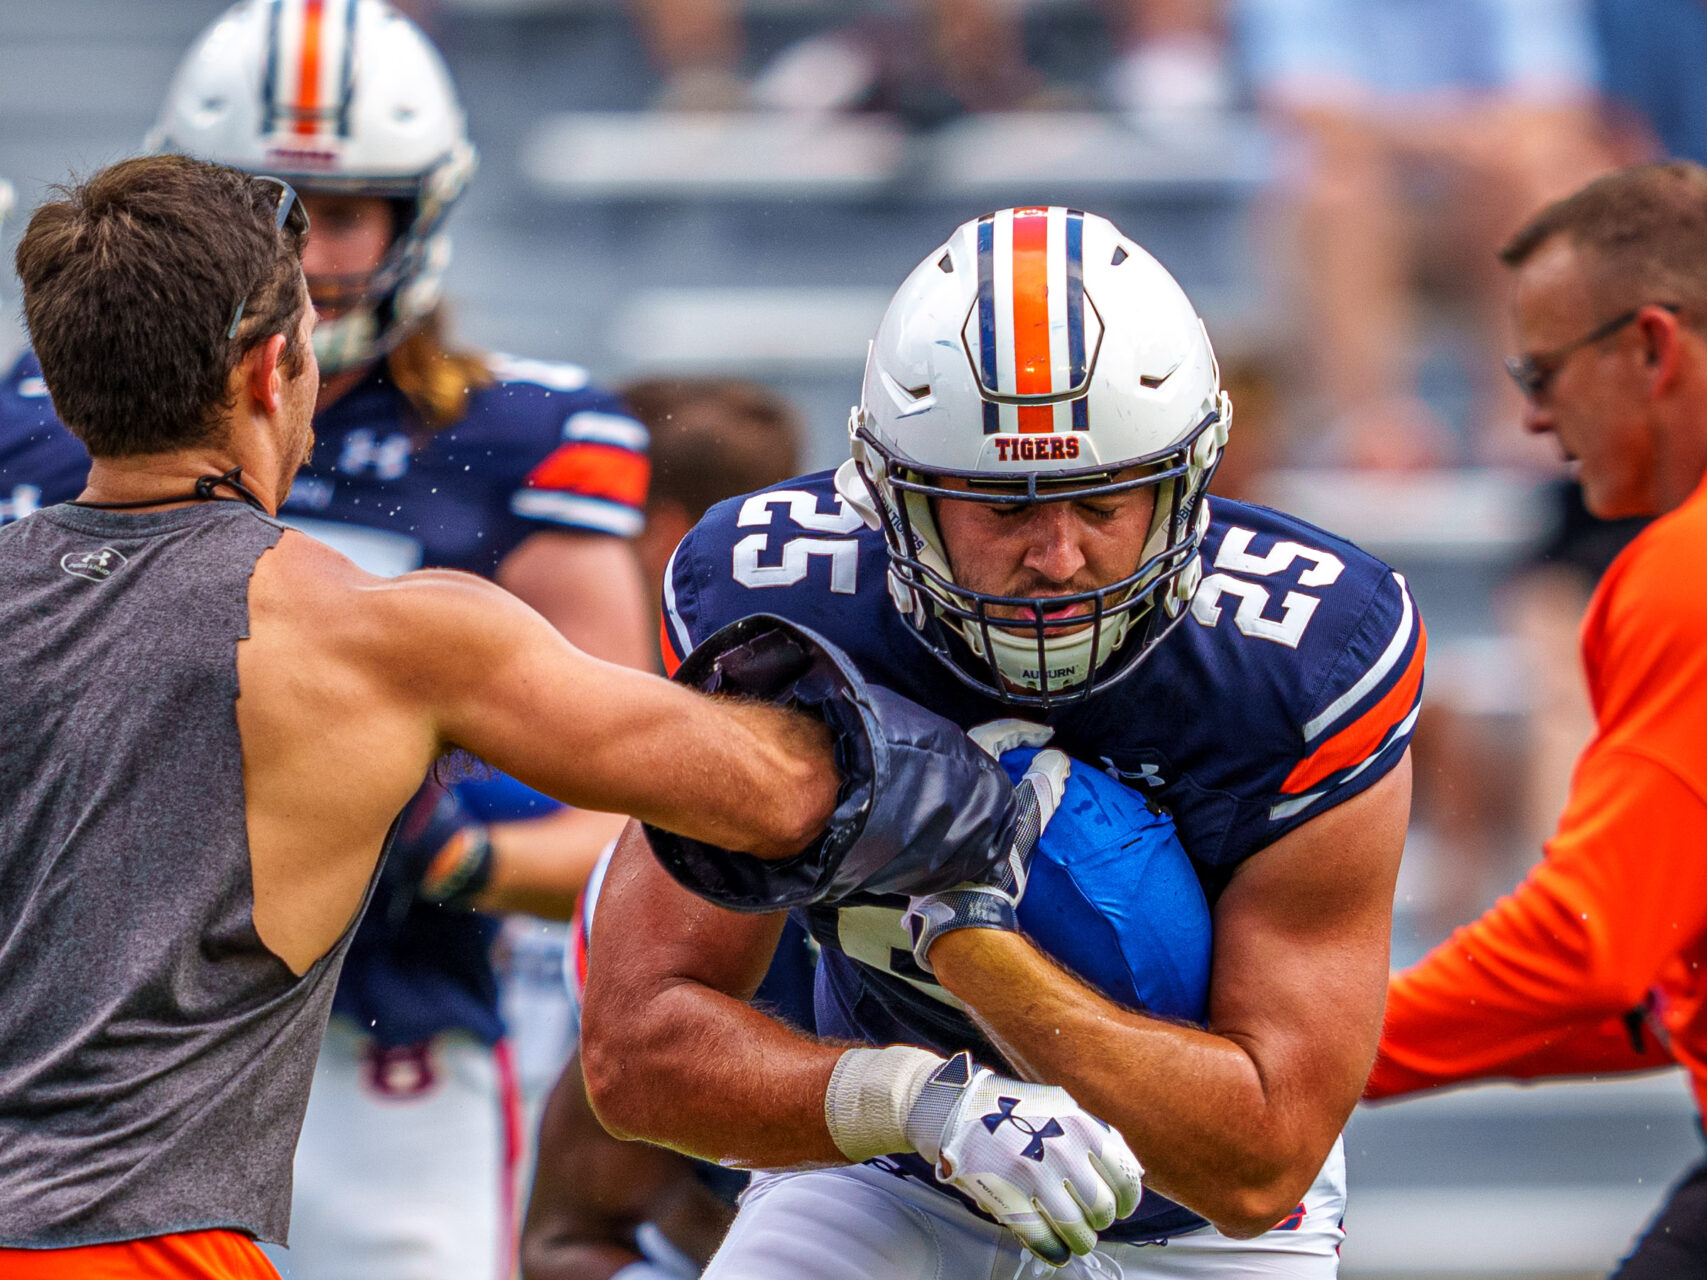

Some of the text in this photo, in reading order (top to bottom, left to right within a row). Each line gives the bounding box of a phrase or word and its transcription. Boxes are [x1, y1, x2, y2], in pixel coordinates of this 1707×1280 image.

[994, 435, 1080, 462] TIGERS
[732, 489, 859, 595] 25
[1189, 526, 1346, 650] 25
[1022, 665, 1076, 679] AUURN
